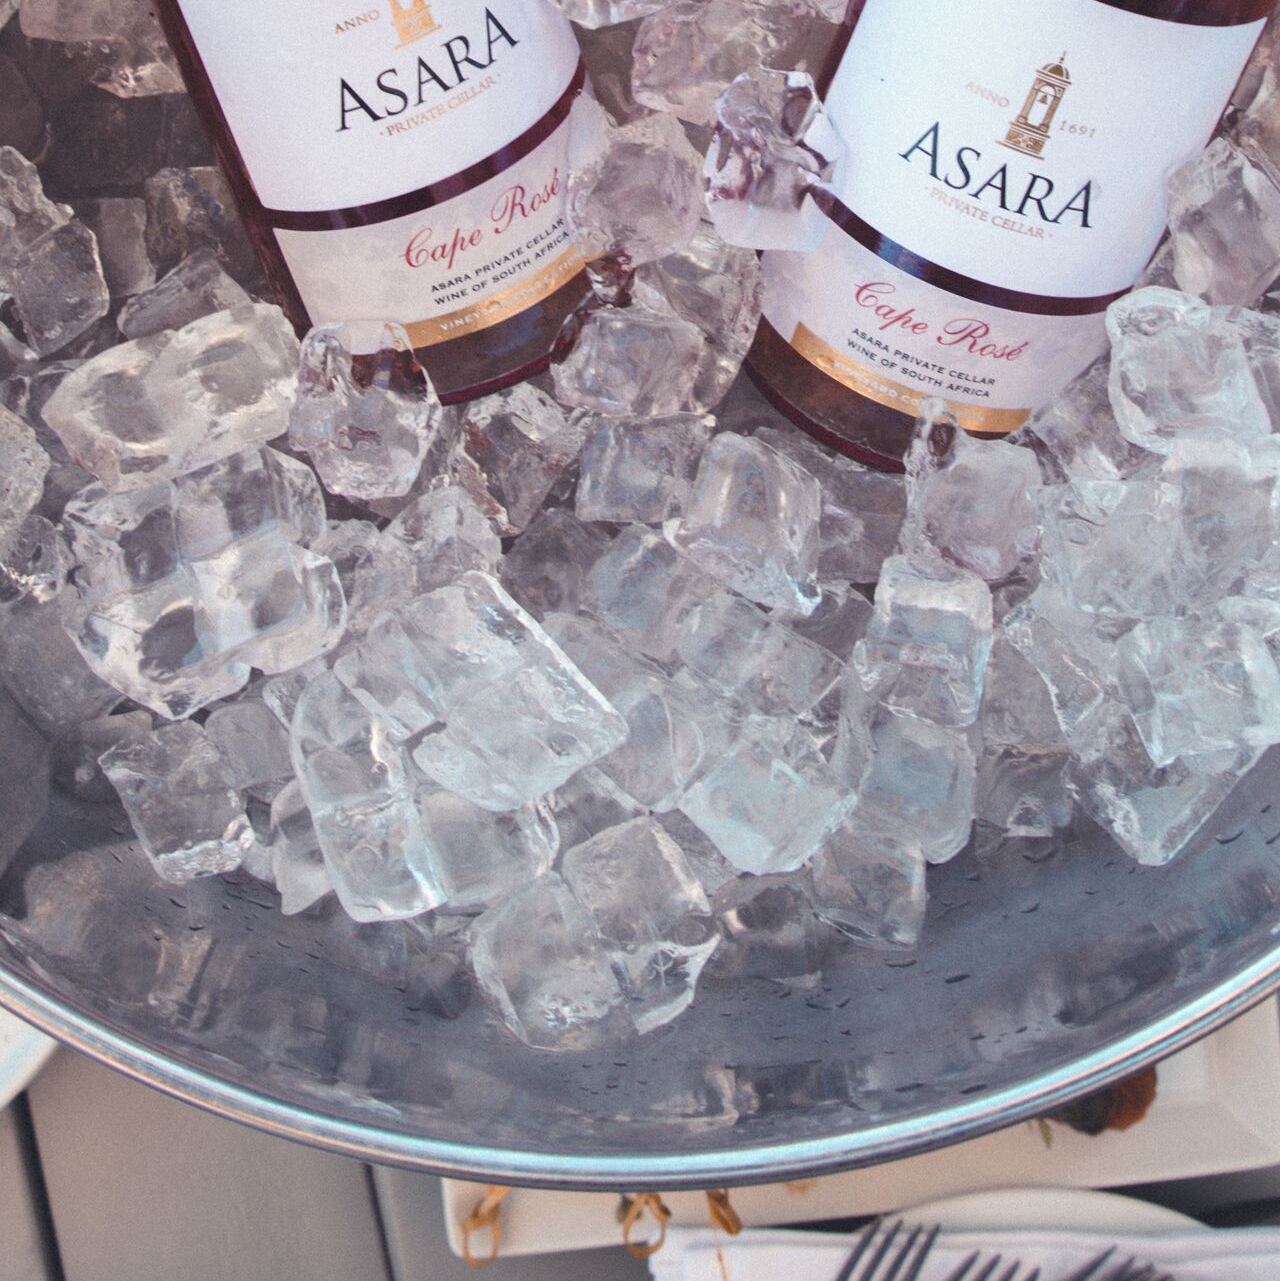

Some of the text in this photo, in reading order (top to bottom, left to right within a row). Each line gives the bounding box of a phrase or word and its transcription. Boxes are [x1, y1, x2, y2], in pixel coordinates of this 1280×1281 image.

[335, 9, 380, 34] ANNO
[336, 7, 519, 132] ASARA
[386, 75, 497, 136] PRIVATE CELLAR
[964, 81, 1095, 138] ANNO 1691
[898, 121, 1093, 229] ASARA
[399, 167, 561, 270] Cape Rosé
[930, 187, 1045, 239] PRIVATE CELLAR
[431, 218, 565, 293] ASARA PRIVATE CELLAR
[433, 230, 570, 306] WINE OF SOUTH AFRICA
[854, 281, 1030, 361] Cape Rosé
[846, 338, 991, 399] WINE OF SOUTH AFRICA
[852, 327, 996, 387] ASARA PRIVATE CELLAR
